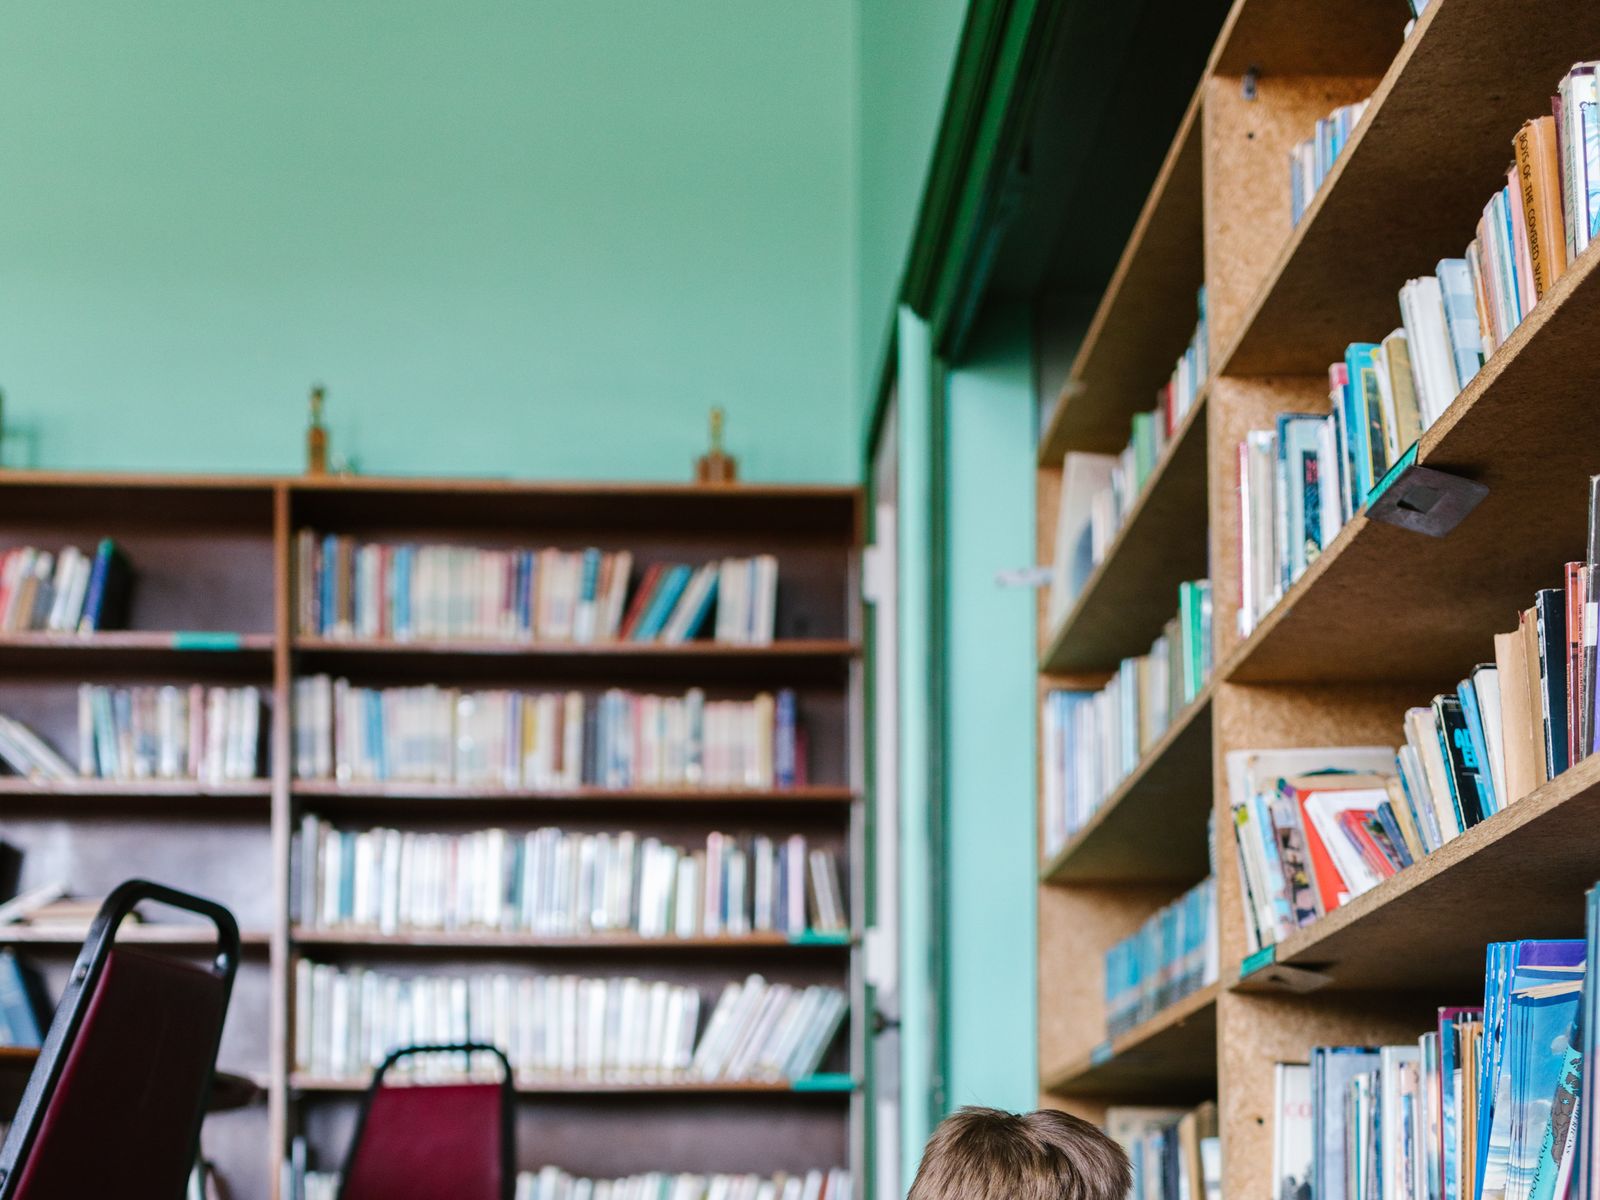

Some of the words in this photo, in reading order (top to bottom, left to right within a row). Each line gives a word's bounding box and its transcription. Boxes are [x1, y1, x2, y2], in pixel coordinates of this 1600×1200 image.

[1519, 133, 1530, 160] BOYS
[1523, 164, 1532, 181] OF
[1525, 184, 1534, 206] THE
[1527, 208, 1539, 261] COVERED
[1534, 262, 1543, 301] WAGO
